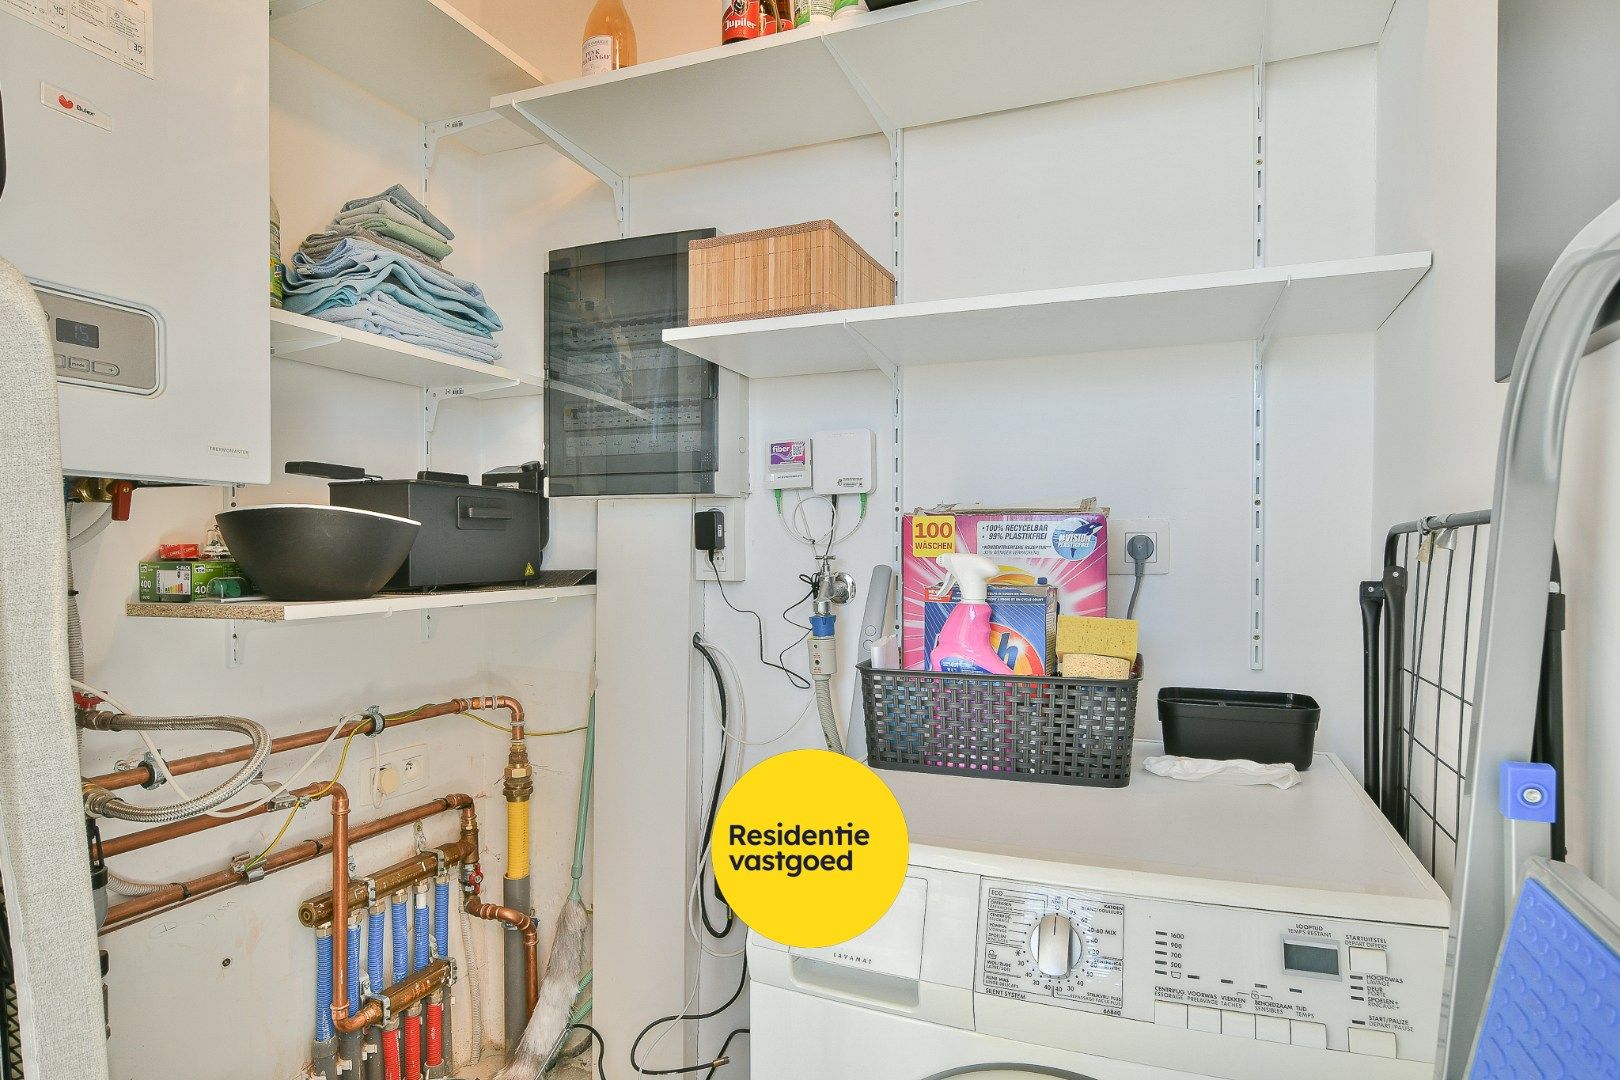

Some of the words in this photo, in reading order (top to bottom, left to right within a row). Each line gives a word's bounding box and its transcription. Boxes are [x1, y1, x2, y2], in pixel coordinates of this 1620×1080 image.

[725, 17, 756, 32] Jupiler
[772, 445, 791, 453] fiber
[914, 522, 953, 539] 100
[914, 541, 953, 550] WÄSCHEN
[140, 580, 152, 588] 400
[194, 586, 206, 594] 40
[1308, 930, 1332, 938] RESTANT
[1346, 934, 1387, 944] STARTUITSTEL
[834, 952, 872, 964] LAVAMAT
[1366, 974, 1404, 984] HOOFDWAS
[1004, 990, 1026, 999] SYSTEM
[1154, 986, 1186, 996] CENTRIFUG.
[1188, 990, 1218, 1000] VOORWAS
[1154, 992, 1184, 1000] ESSORAGE
[1220, 1000, 1242, 1008] TACHES
[1254, 1000, 1294, 1010] BEHOEDZAAM
[1254, 1006, 1284, 1014] SENSIBLES
[1368, 1015, 1409, 1026] START/PAUZE
